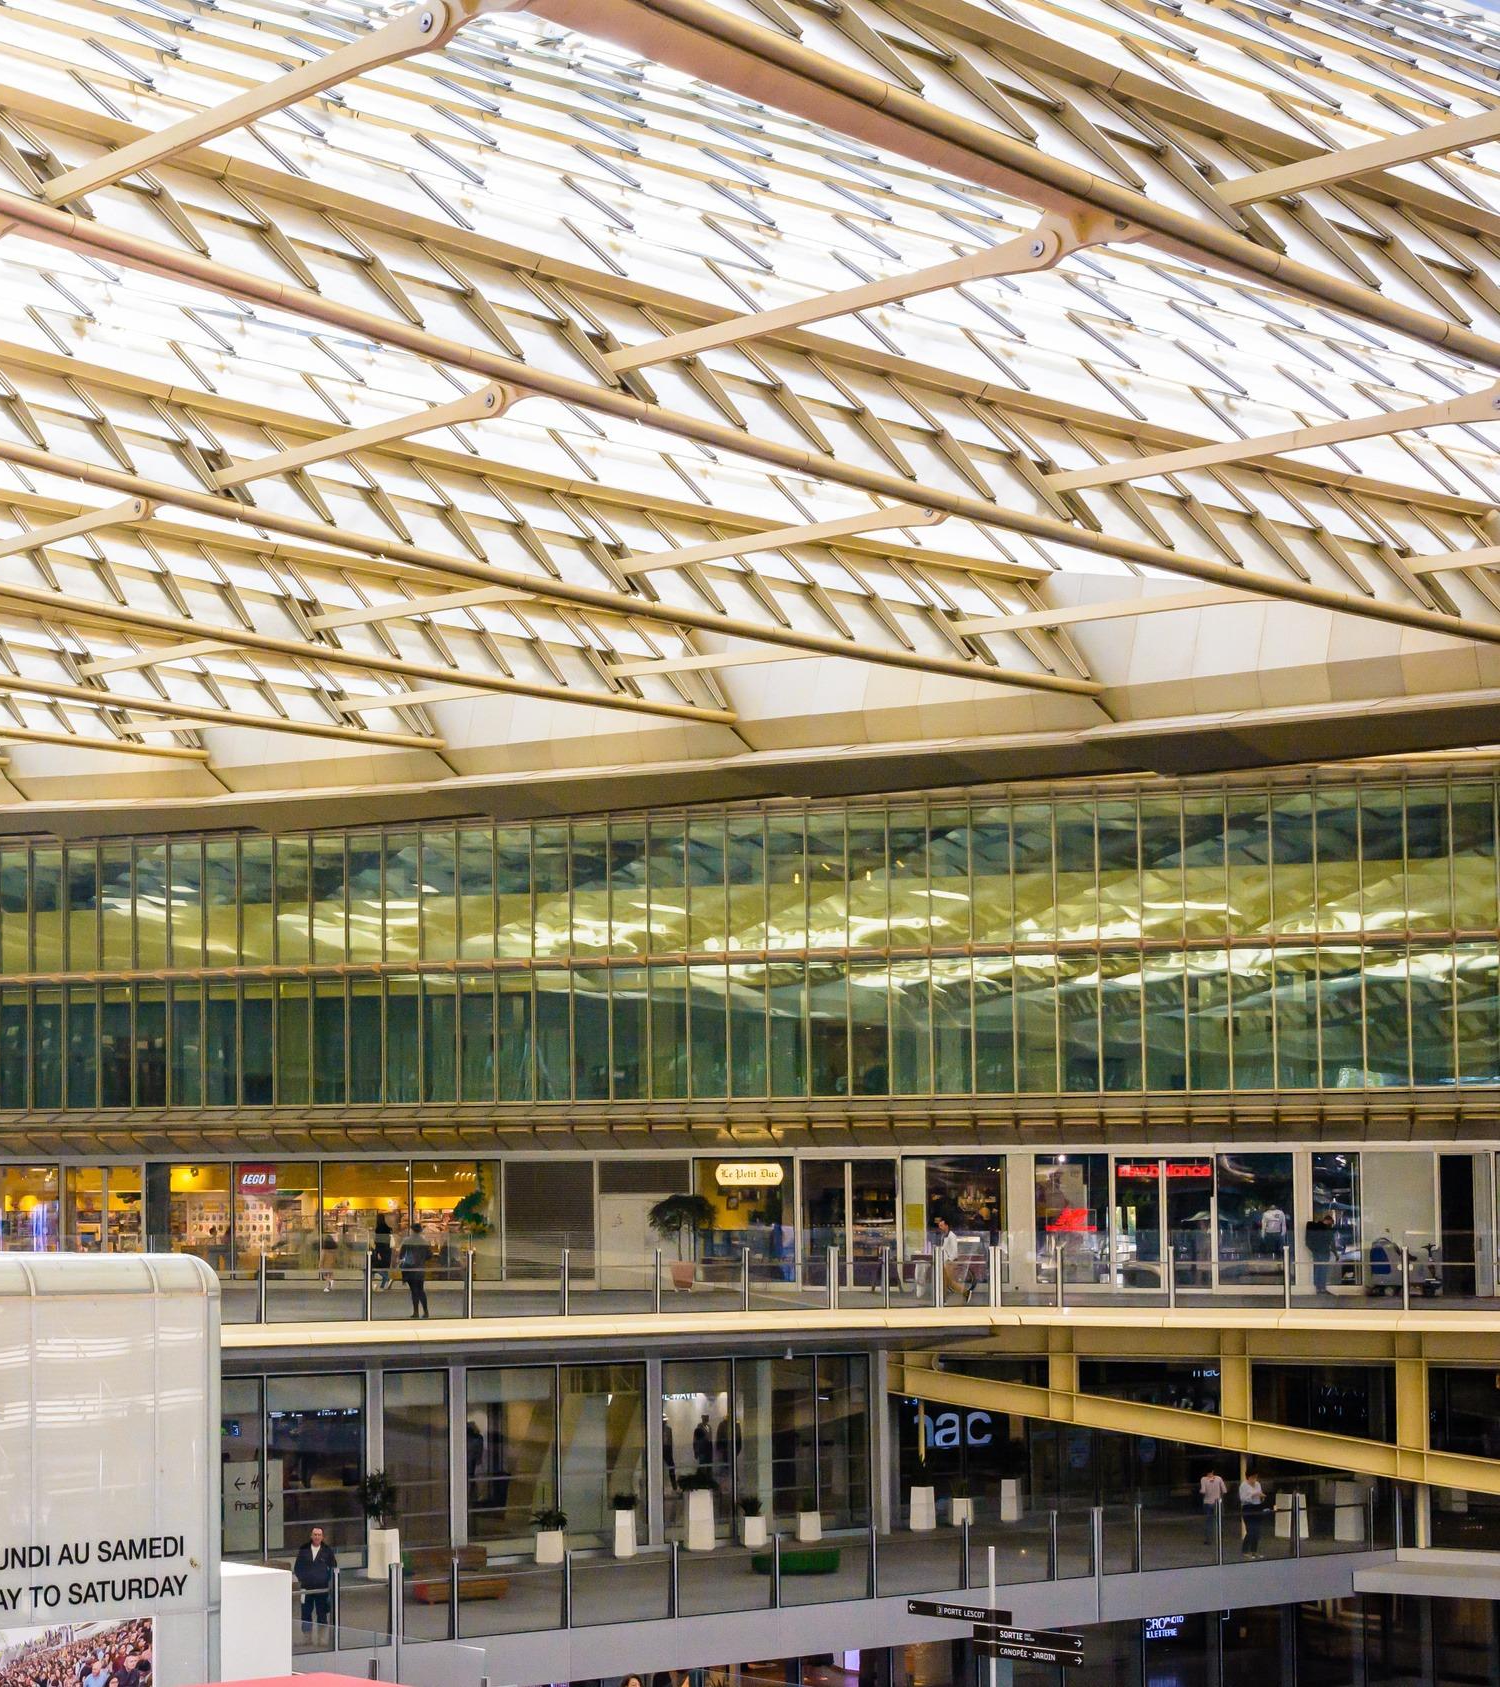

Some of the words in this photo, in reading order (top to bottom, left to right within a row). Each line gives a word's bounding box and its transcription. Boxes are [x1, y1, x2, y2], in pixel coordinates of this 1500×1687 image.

[760, 1168, 779, 1178] Duc
[242, 1174, 266, 1185] LEGO
[57, 1542, 90, 1566] AU
[97, 1535, 184, 1563] SAMEDI
[28, 1584, 61, 1608] TO
[68, 1574, 188, 1605] SATURDAY
[943, 1607, 962, 1617] PORTE
[963, 1609, 986, 1619] LESCOT
[999, 1630, 1024, 1641] SORTIE
[999, 1647, 1028, 1659] CANOPÉE
[1032, 1651, 1056, 1661] JARDIN
